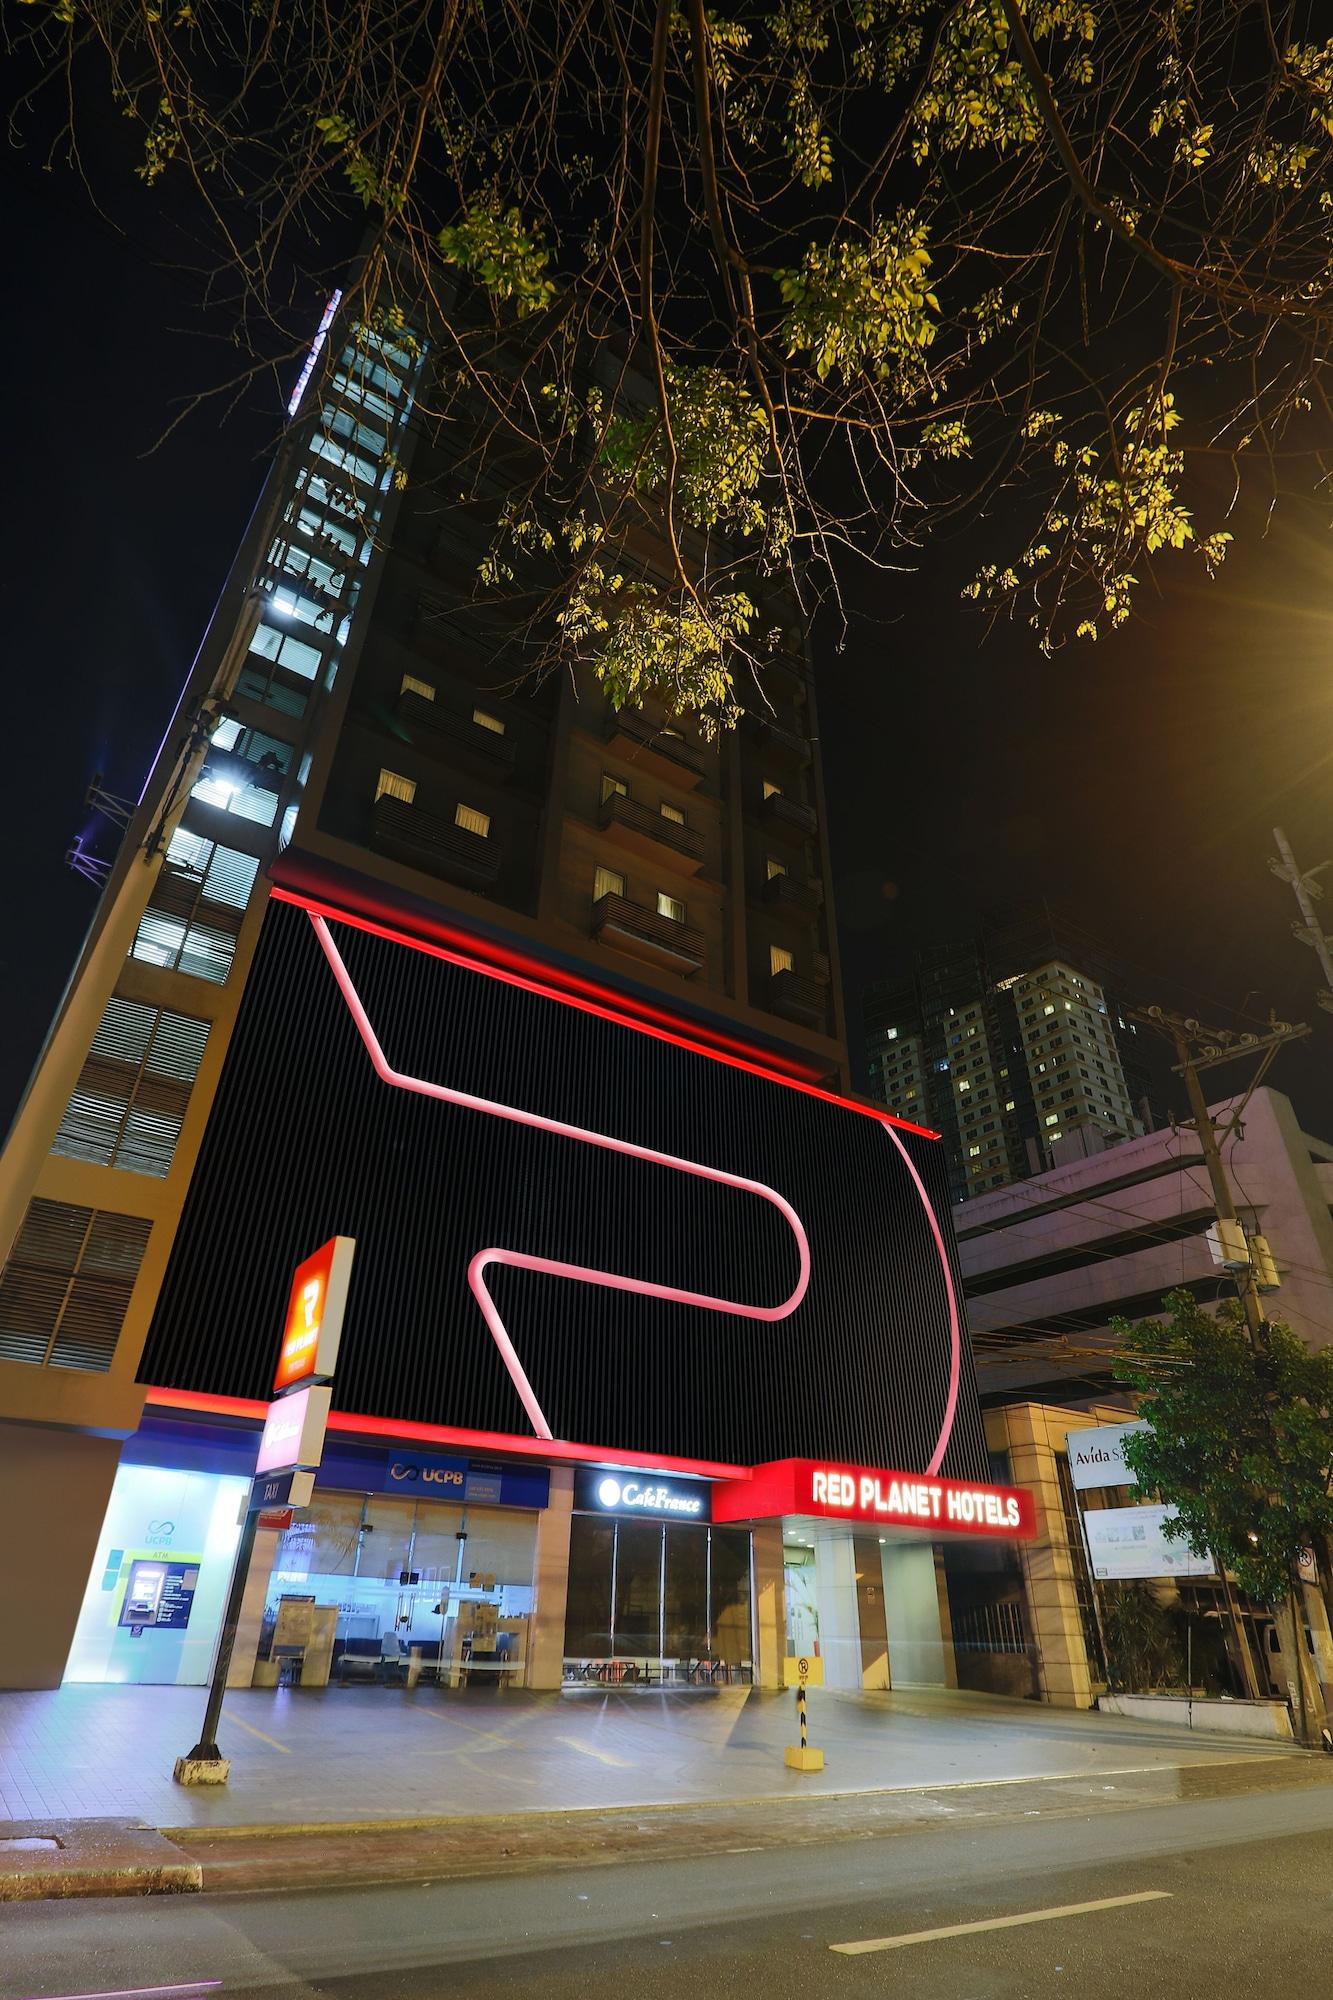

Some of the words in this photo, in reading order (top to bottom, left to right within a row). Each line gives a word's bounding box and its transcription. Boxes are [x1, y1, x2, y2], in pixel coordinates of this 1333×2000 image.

[422, 1467, 464, 1486] UCPB
[264, 1482, 280, 1501] TAXI
[812, 1471, 856, 1506] RED
[860, 1477, 942, 1518] PLANET
[946, 1489, 1020, 1527] HOTELS
[145, 1536, 172, 1546] UCPB
[152, 1551, 169, 1559] ATM
